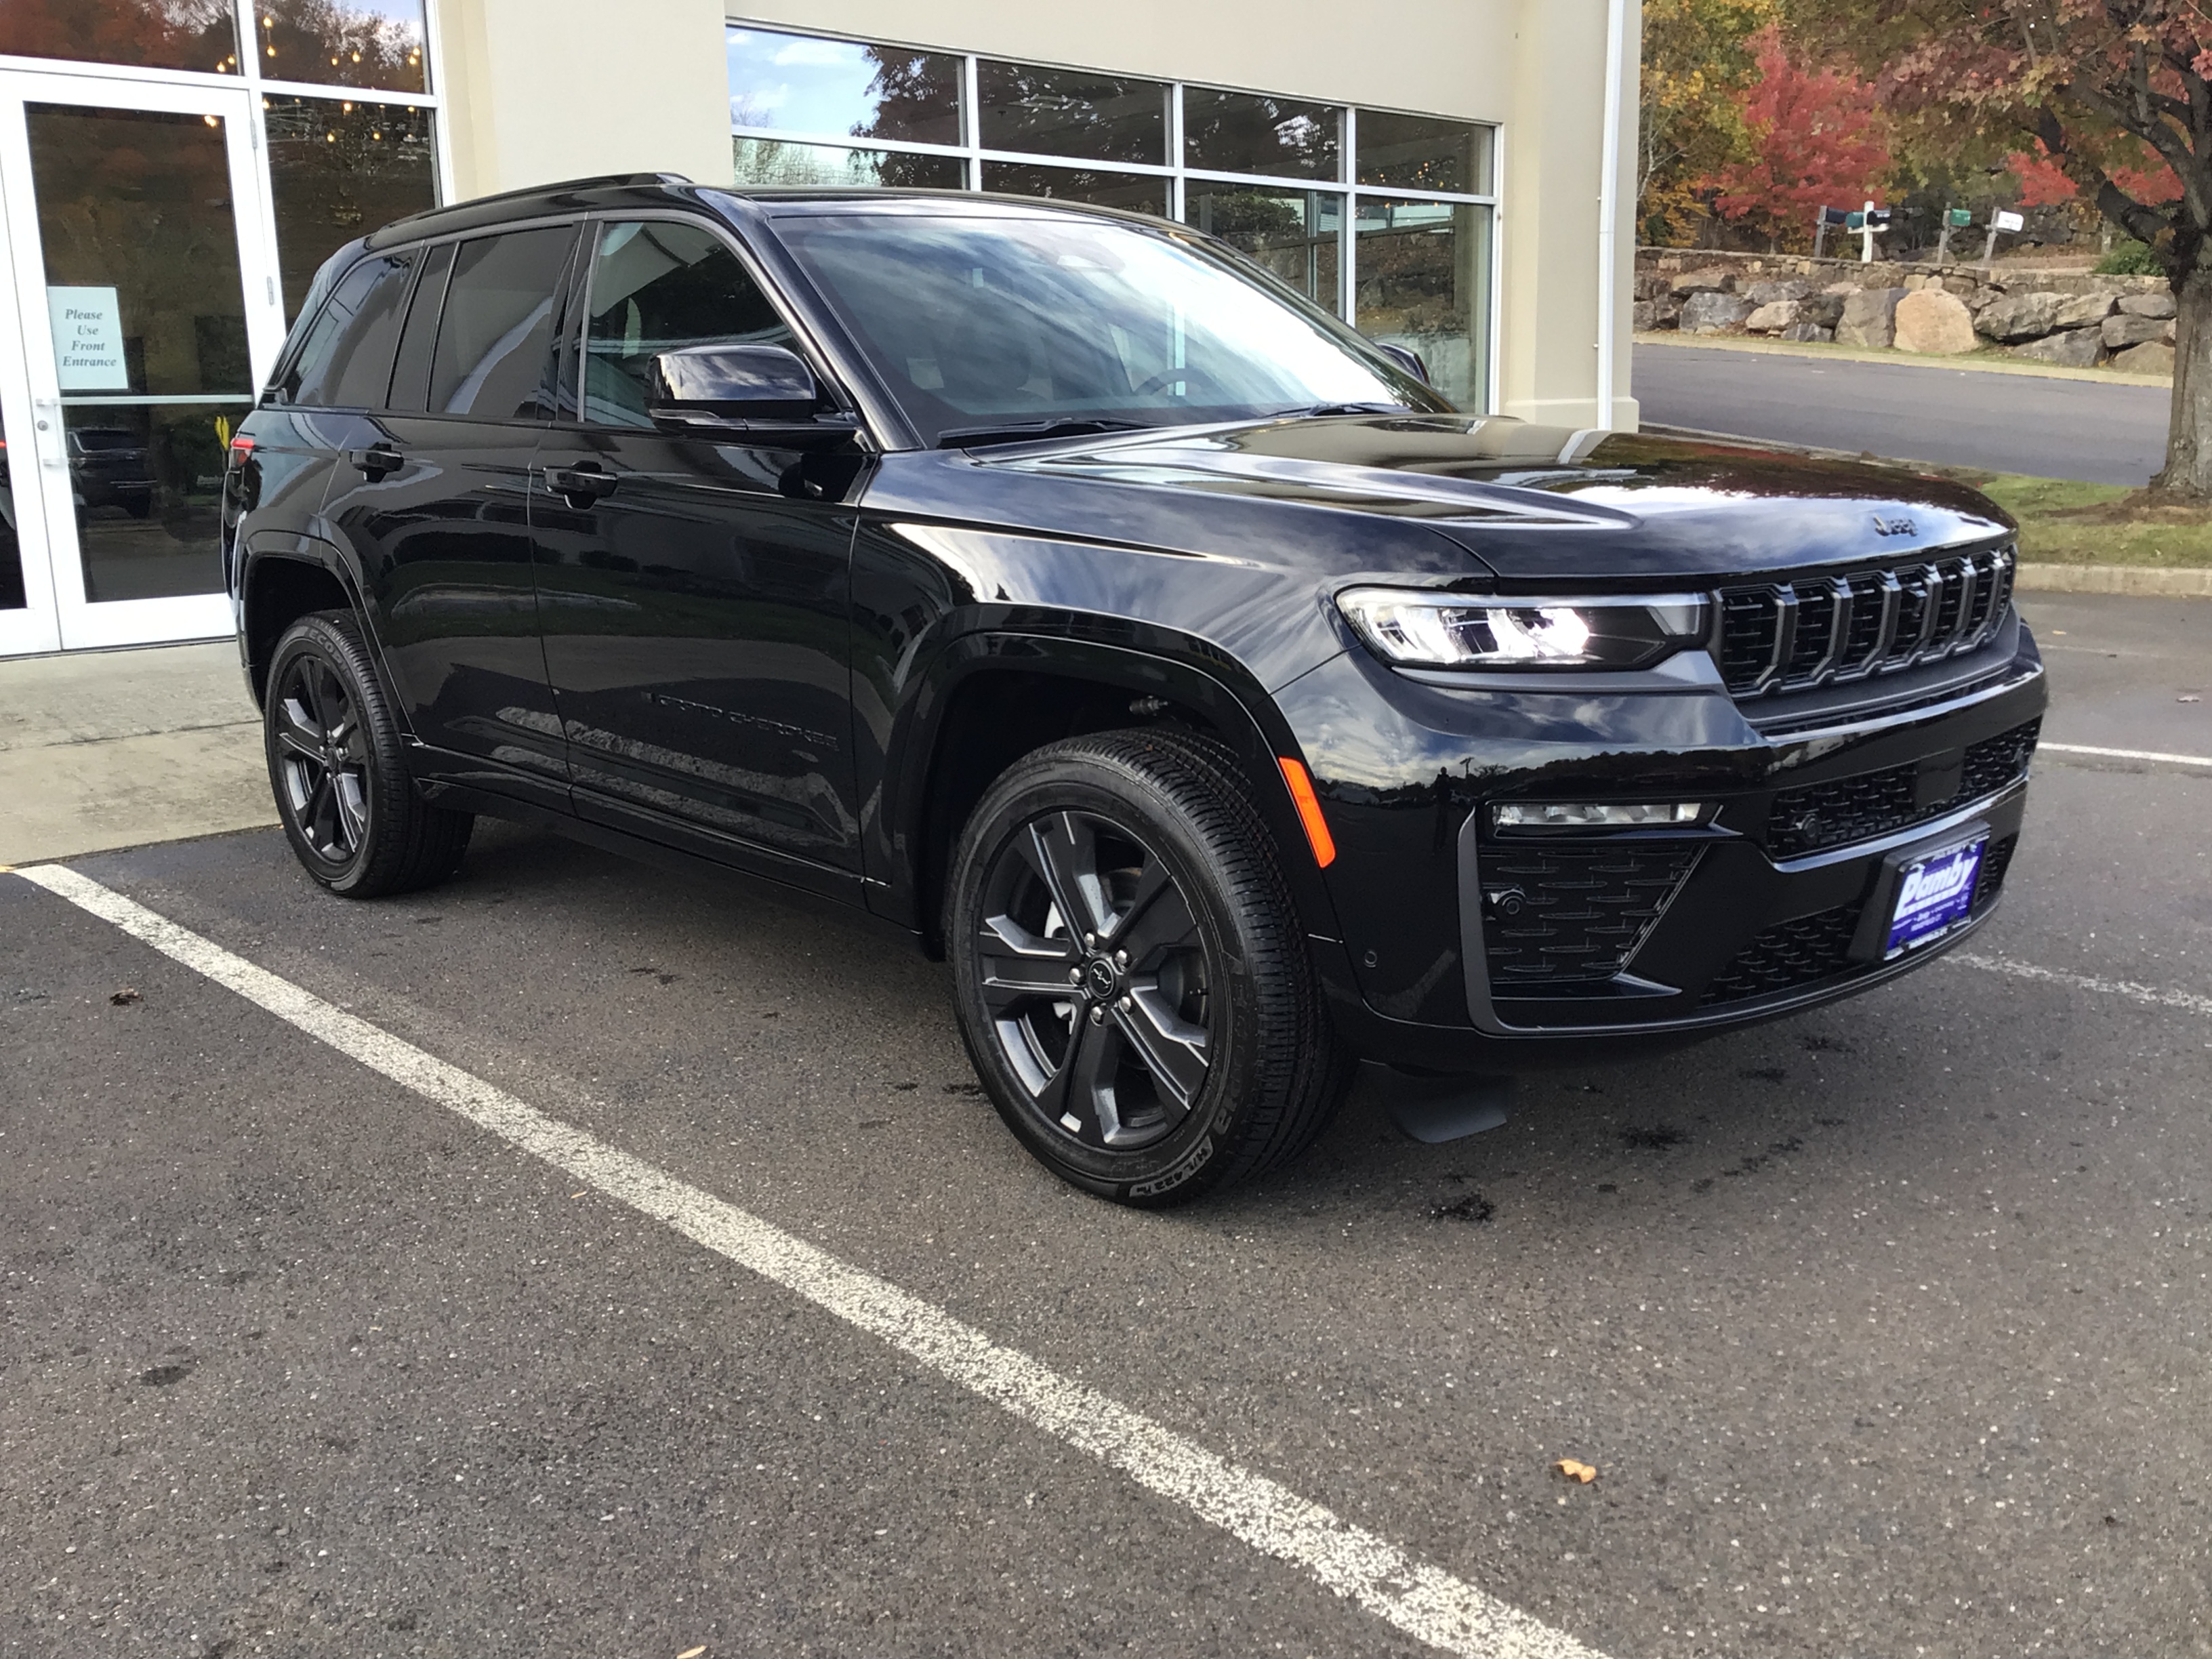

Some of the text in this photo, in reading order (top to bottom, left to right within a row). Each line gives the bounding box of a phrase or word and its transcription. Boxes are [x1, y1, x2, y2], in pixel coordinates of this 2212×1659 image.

[65, 308, 103, 320] Please
[77, 325, 99, 335] Use
[70, 340, 105, 351] Front
[62, 356, 117, 367] Entrance
[1872, 513, 1919, 537] Jeep
[1893, 853, 1979, 922] Pamby
